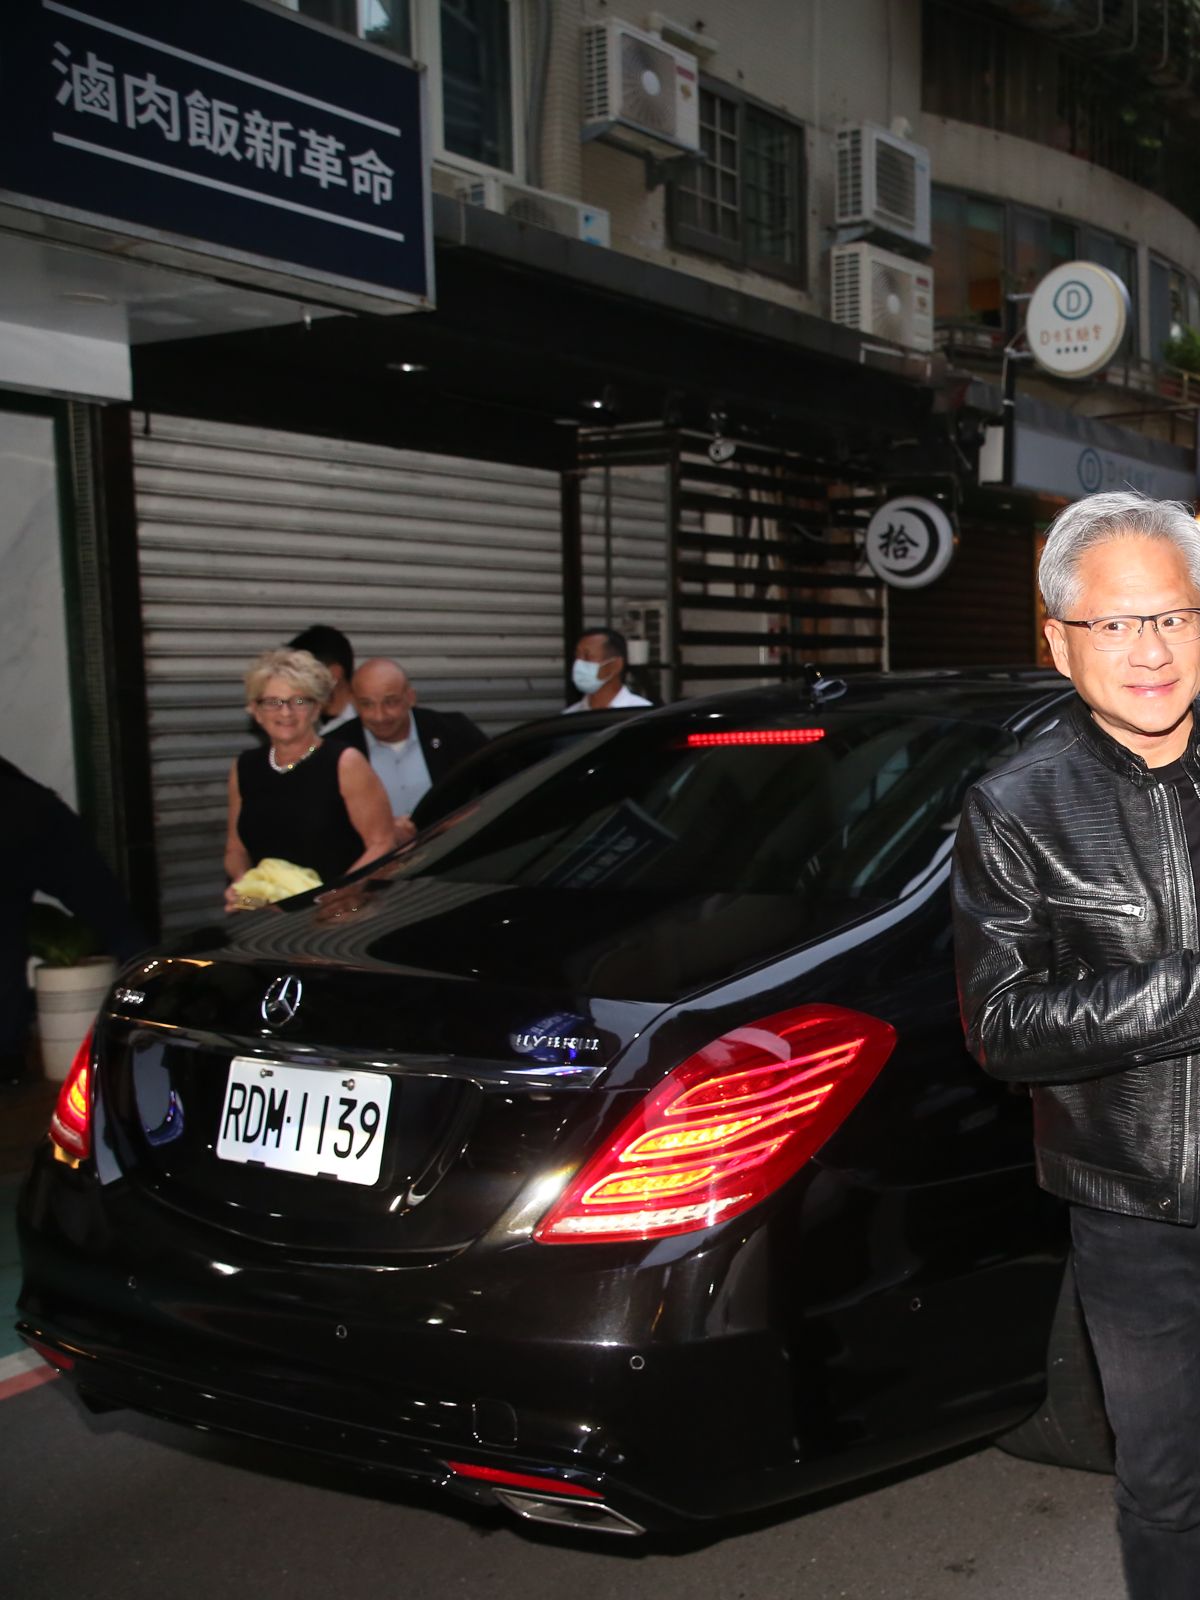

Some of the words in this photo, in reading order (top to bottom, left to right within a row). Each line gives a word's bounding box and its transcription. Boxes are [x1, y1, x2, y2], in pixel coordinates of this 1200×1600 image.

[51, 40, 395, 205] 滷肉飯新革命
[878, 522, 919, 560] 拾
